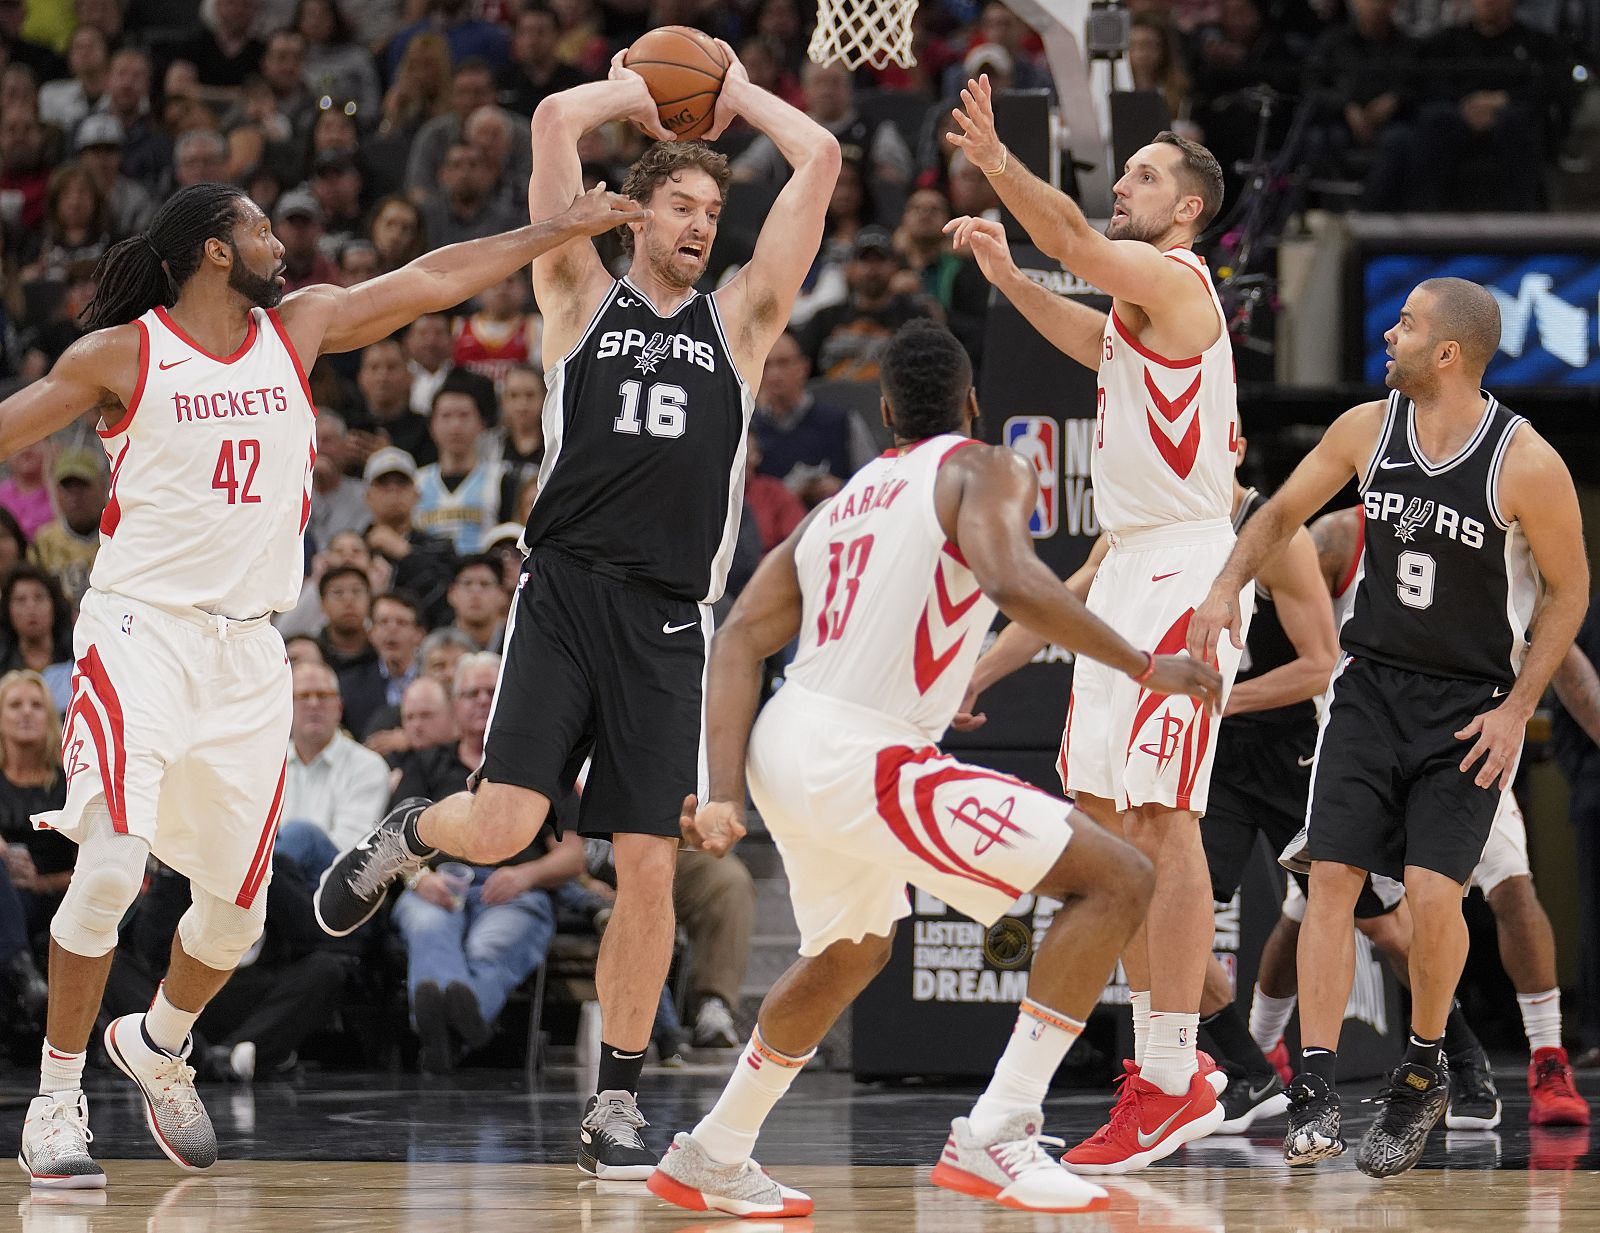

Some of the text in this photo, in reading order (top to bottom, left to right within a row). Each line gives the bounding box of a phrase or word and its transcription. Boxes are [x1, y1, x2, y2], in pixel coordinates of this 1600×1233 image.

[596, 328, 716, 376] SPURS
[170, 386, 288, 423] ROCKETS
[612, 379, 688, 439] 16
[211, 438, 262, 505] 42
[1364, 491, 1485, 549] SPURS
[816, 533, 875, 648] 13
[1396, 549, 1436, 611] 9
[914, 921, 985, 945] LISTEN
